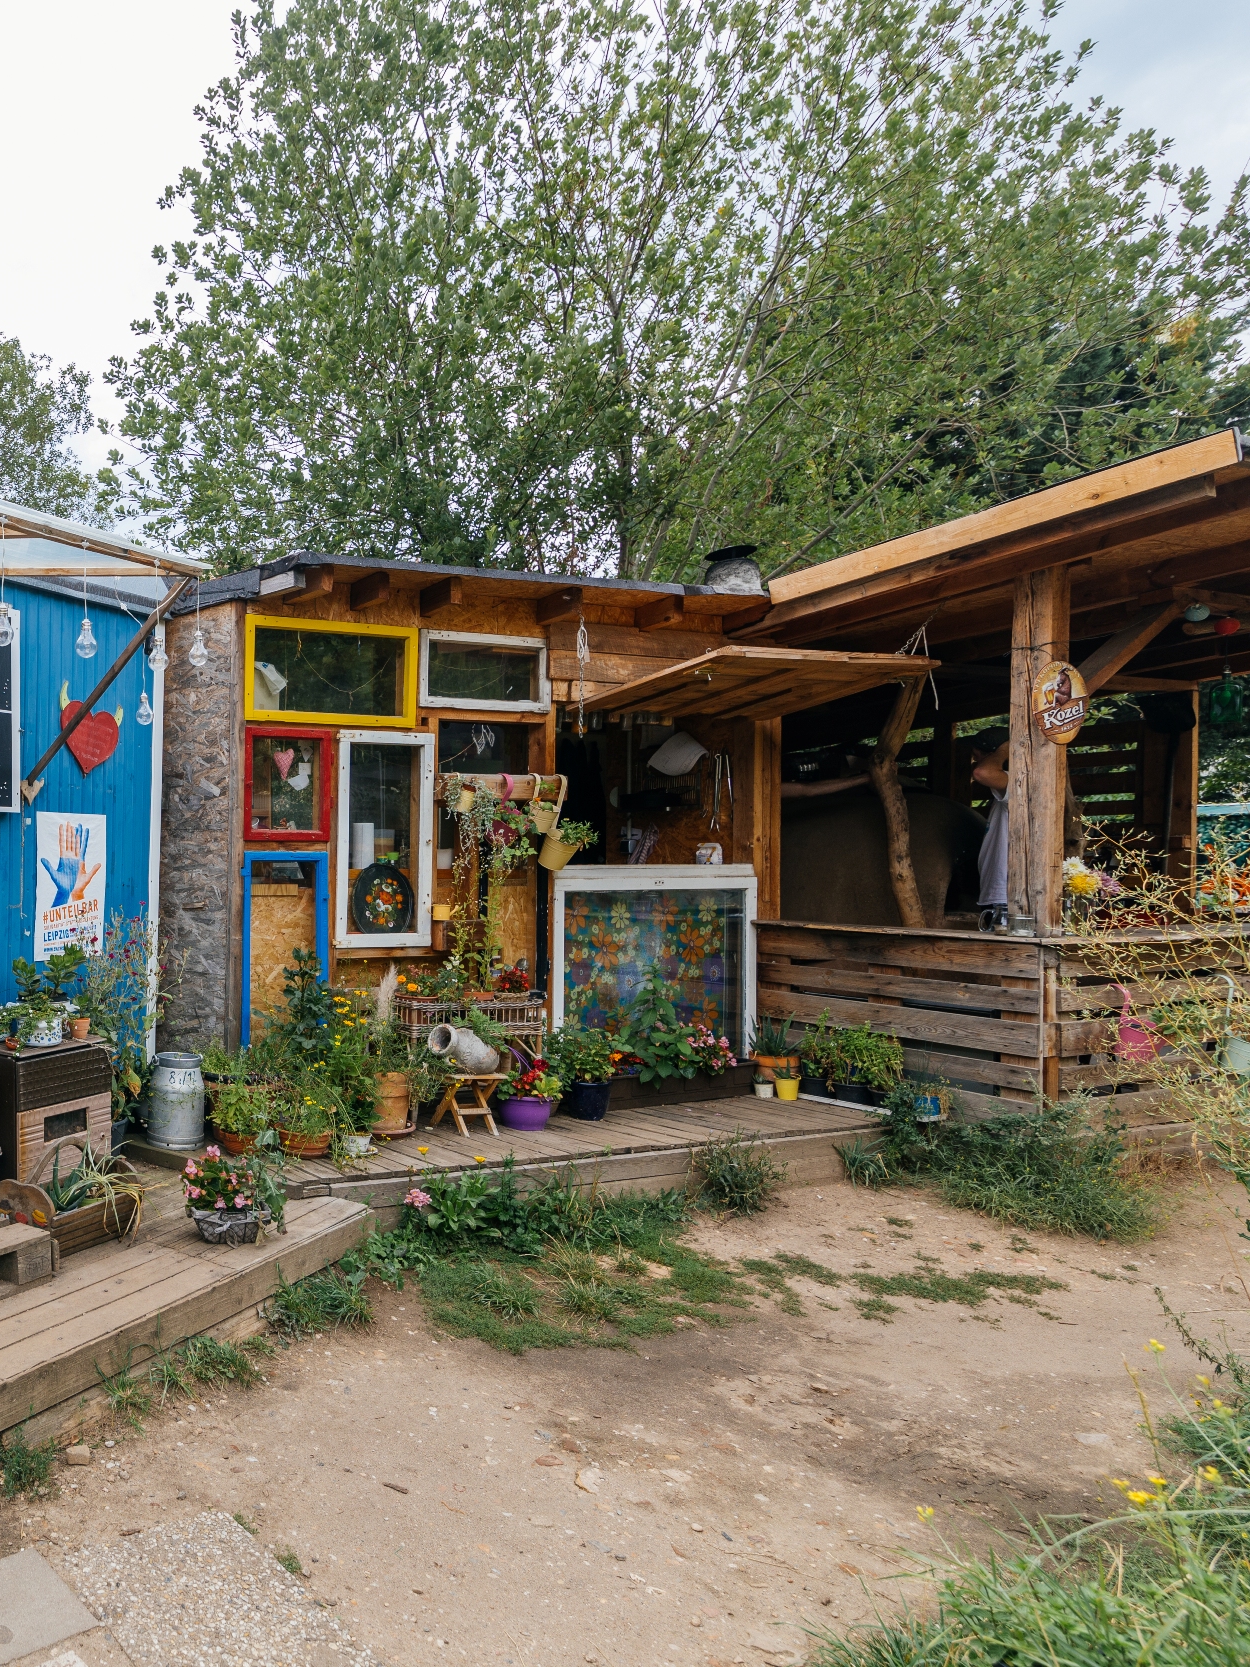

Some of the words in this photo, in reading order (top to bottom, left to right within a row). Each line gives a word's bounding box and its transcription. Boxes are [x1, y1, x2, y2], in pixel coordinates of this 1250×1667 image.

[1042, 700, 1084, 730] Kozel
[43, 899, 99, 924] #UNTEILBAR
[44, 929, 69, 942] LEIPZIG
